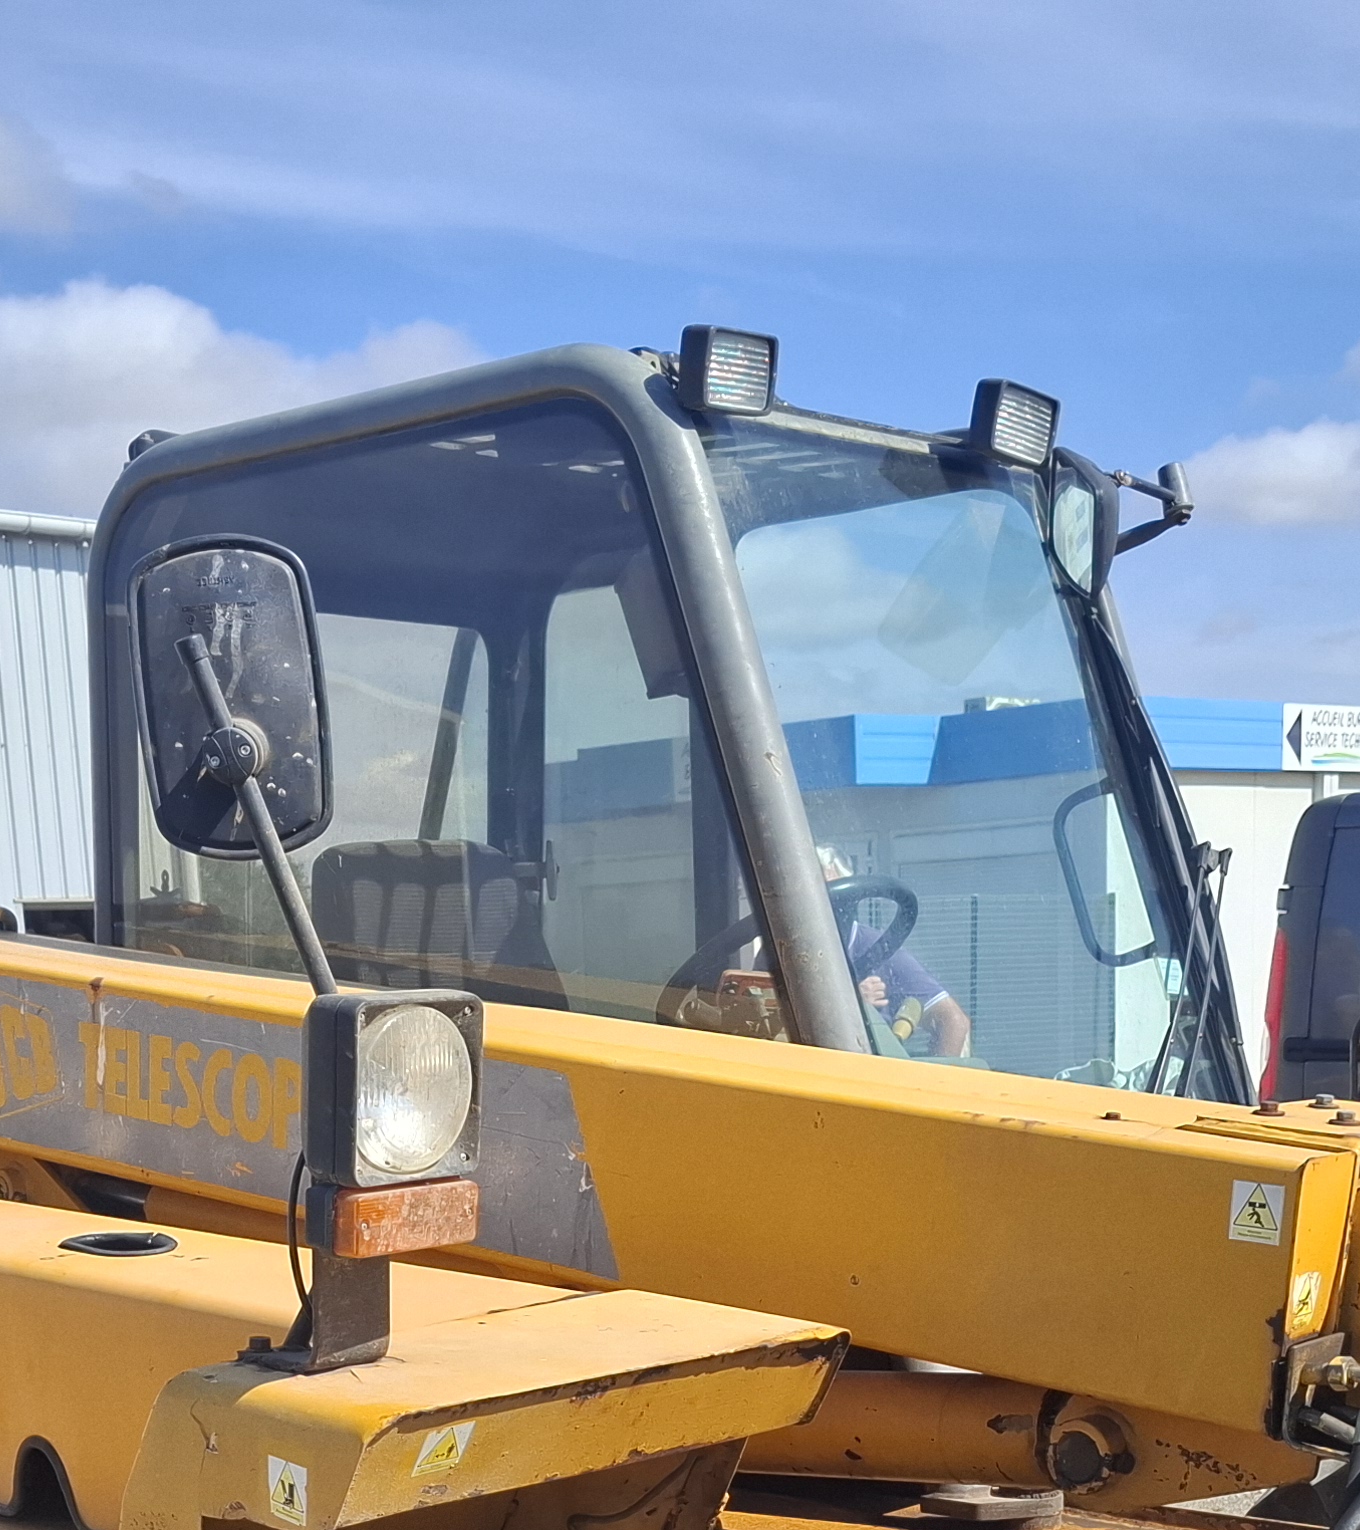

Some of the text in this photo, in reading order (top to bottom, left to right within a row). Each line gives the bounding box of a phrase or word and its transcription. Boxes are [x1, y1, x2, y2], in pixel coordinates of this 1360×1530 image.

[1311, 709, 1345, 728] ACCUEIL
[1304, 731, 1339, 749] SERVICE
[78, 1020, 303, 1150] TELESCOP
